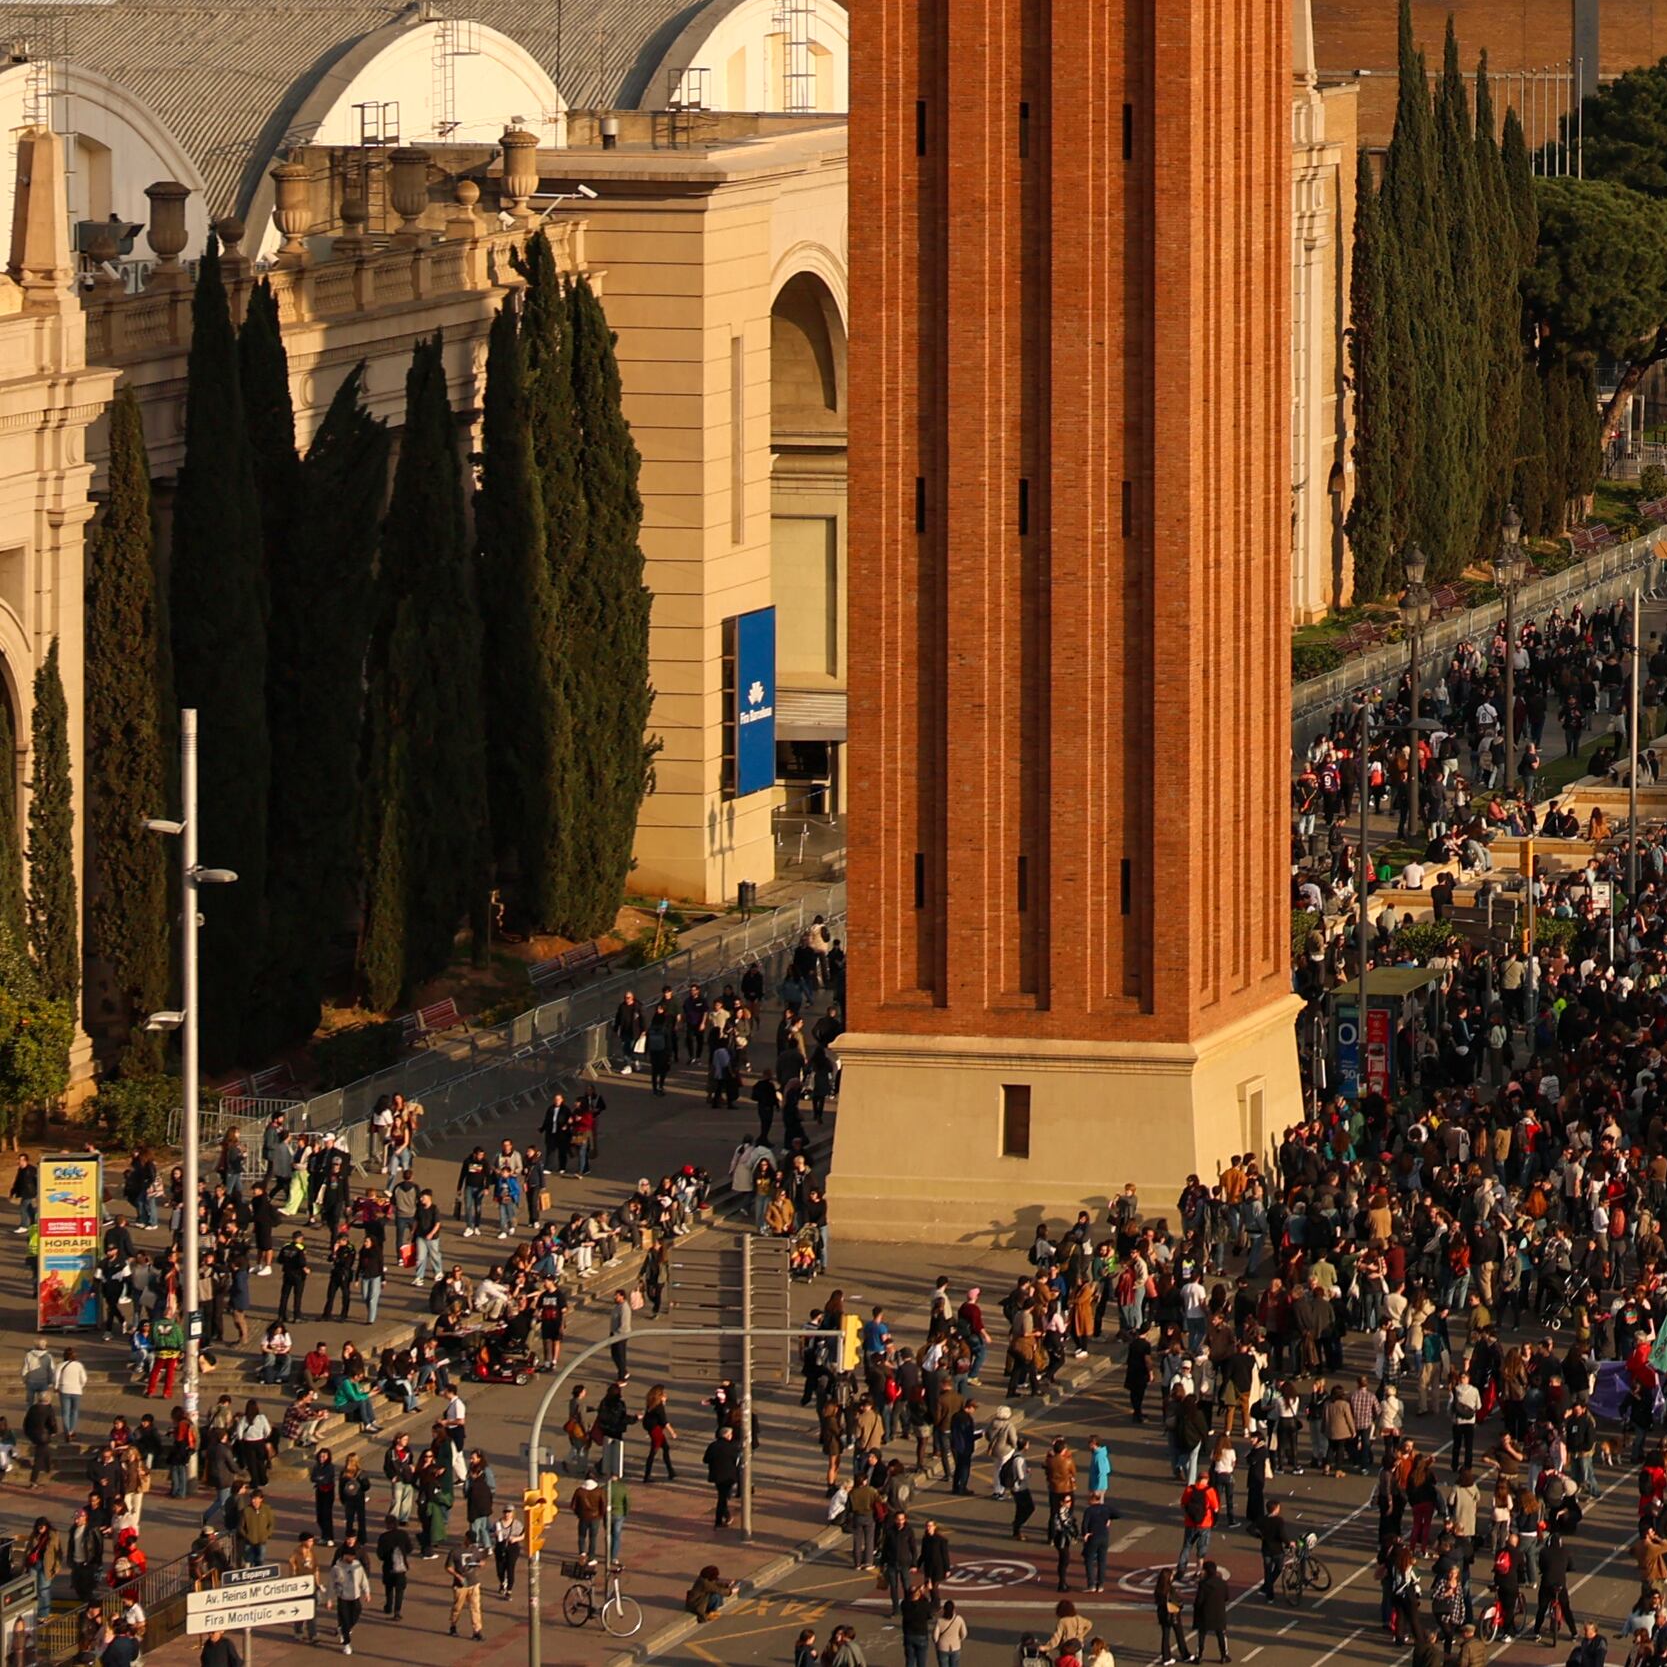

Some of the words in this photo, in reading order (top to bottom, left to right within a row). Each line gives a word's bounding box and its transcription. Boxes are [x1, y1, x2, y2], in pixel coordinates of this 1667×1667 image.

[1323, 774, 1331, 787] 9
[44, 1239, 92, 1248] HORARI
[231, 1571, 240, 1582] Pl.
[241, 1568, 271, 1581] Espanya
[205, 1593, 220, 1605] Av.
[222, 1590, 247, 1603] Reina
[263, 1581, 298, 1596] Cristina
[204, 1614, 224, 1627] Fira
[227, 1607, 272, 1625] Montjuïc
